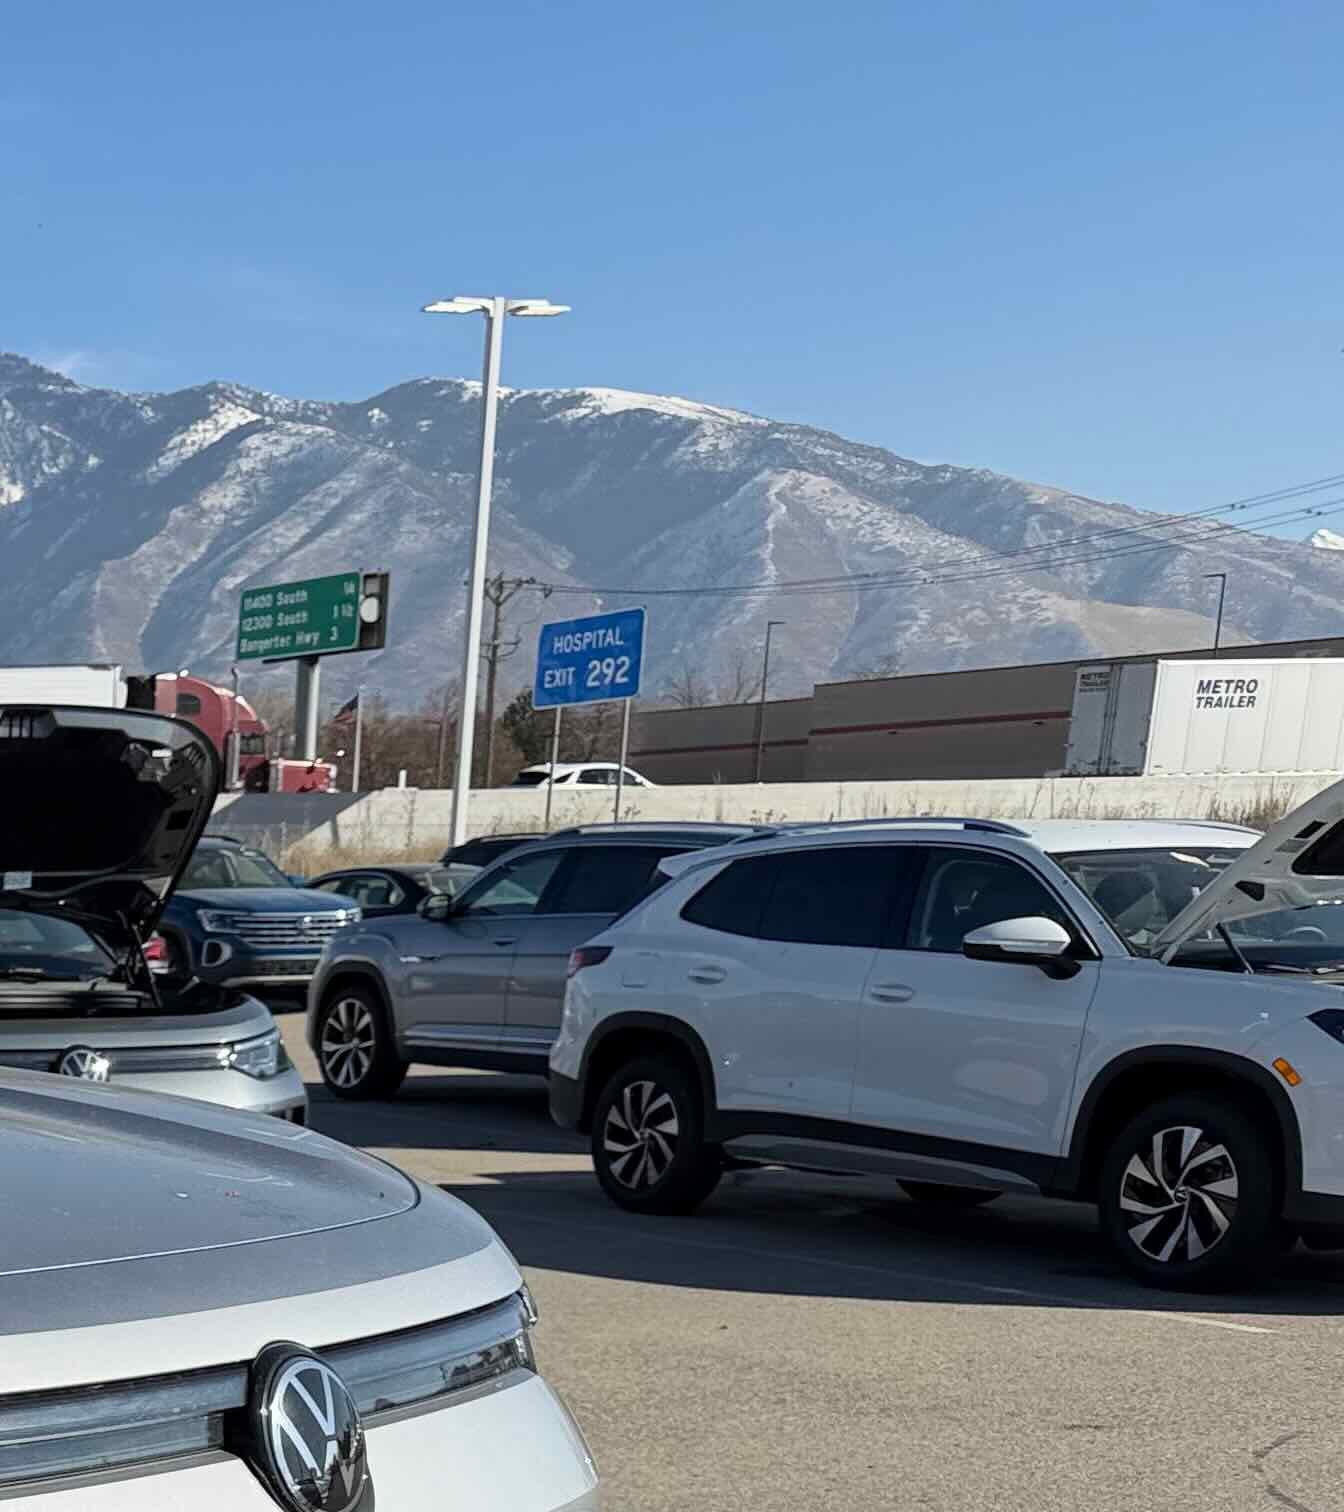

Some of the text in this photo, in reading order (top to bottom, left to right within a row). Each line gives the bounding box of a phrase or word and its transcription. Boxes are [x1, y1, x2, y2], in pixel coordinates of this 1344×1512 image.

[276, 590, 308, 606] South
[276, 611, 308, 626] South
[295, 631, 320, 646] Hwy
[329, 625, 338, 641] 3
[553, 626, 624, 655] HOSPITAL
[544, 655, 630, 688] EXIT 292
[1197, 679, 1258, 695] METRO
[1196, 695, 1257, 709] TRAILER
